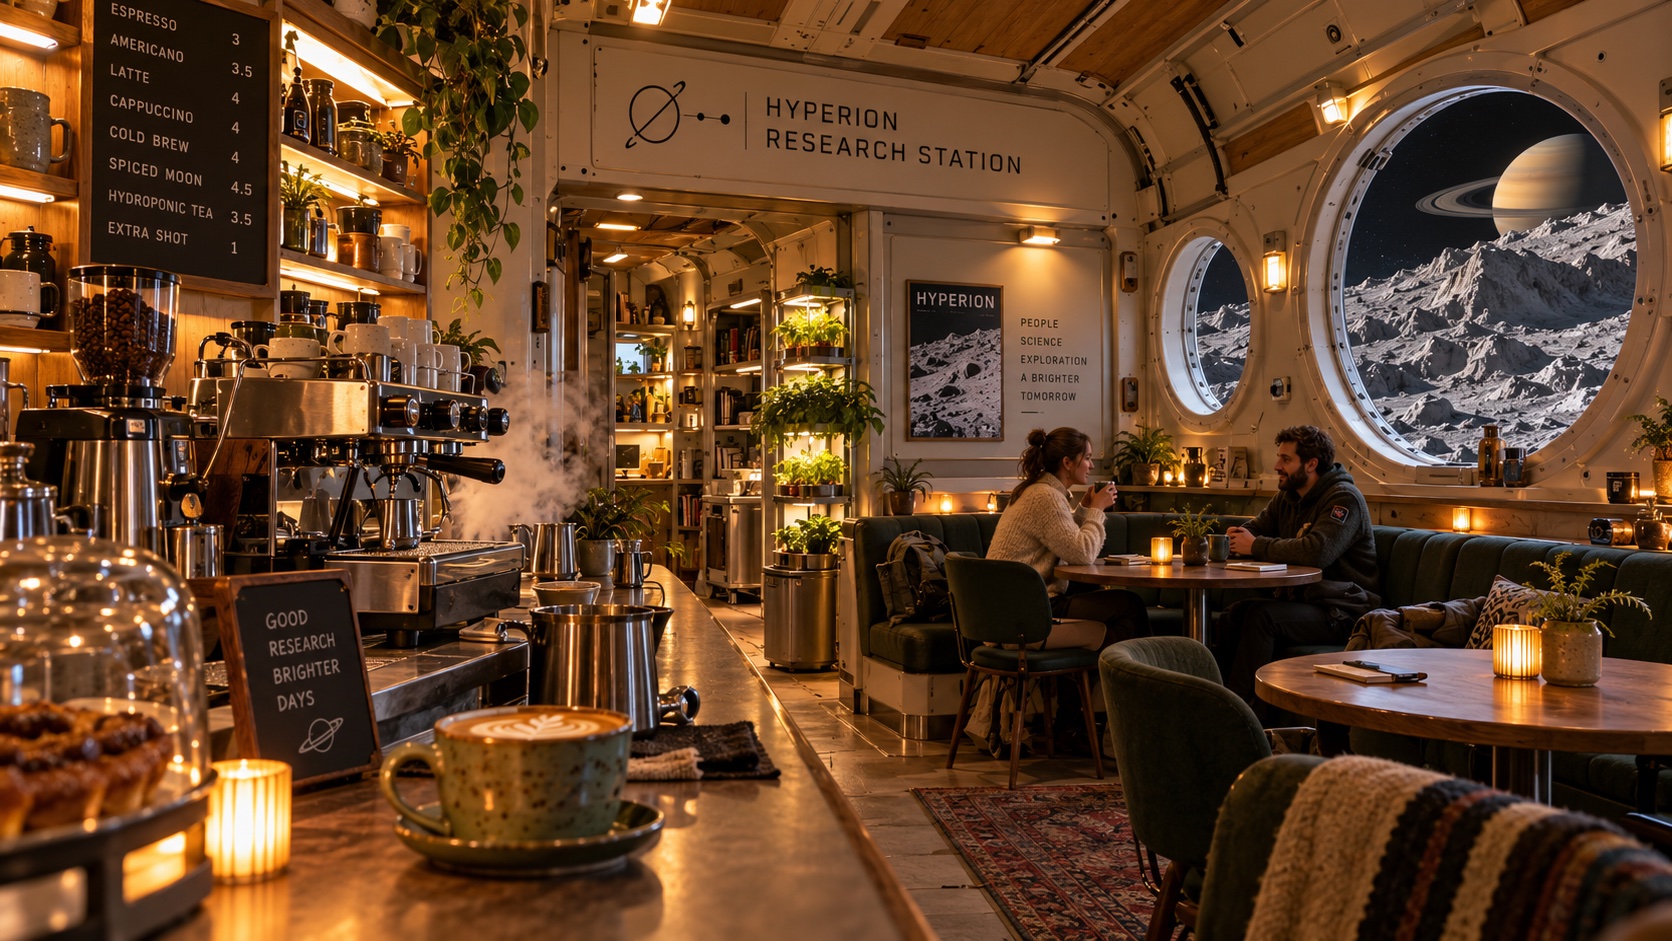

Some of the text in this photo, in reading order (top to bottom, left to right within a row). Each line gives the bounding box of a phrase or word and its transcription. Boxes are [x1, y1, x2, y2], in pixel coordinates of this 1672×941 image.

[111, 2, 240, 46] ESPRESSO 3
[110, 33, 253, 78] AMERICANO 3.5
[110, 63, 240, 105] LATTE 4
[110, 94, 240, 134] CAPPUCCINO 4
[766, 96, 897, 131] HYPERION
[109, 125, 240, 164] COLD BREW 4
[766, 128, 1021, 175] RESEARCH STATION
[109, 157, 252, 196] SPICED MOON 4.5
[108, 189, 252, 226] HYDROPONIC TEA 3.5
[108, 221, 238, 255] EXTRA SHOT 1
[916, 291, 995, 310] HYPERION
[1020, 317, 1059, 329] PEOPLE
[1020, 336, 1063, 347] SCIENCE
[1020, 354, 1088, 366] EXPLORATION
[1020, 372, 1080, 384] A BRIGHTER
[1020, 391, 1077, 402] TOMORROW
[265, 609, 308, 630] GOOD
[268, 632, 336, 657] RESEARCH
[273, 658, 341, 685] BRIGHTER
[276, 689, 315, 712] DAYS
